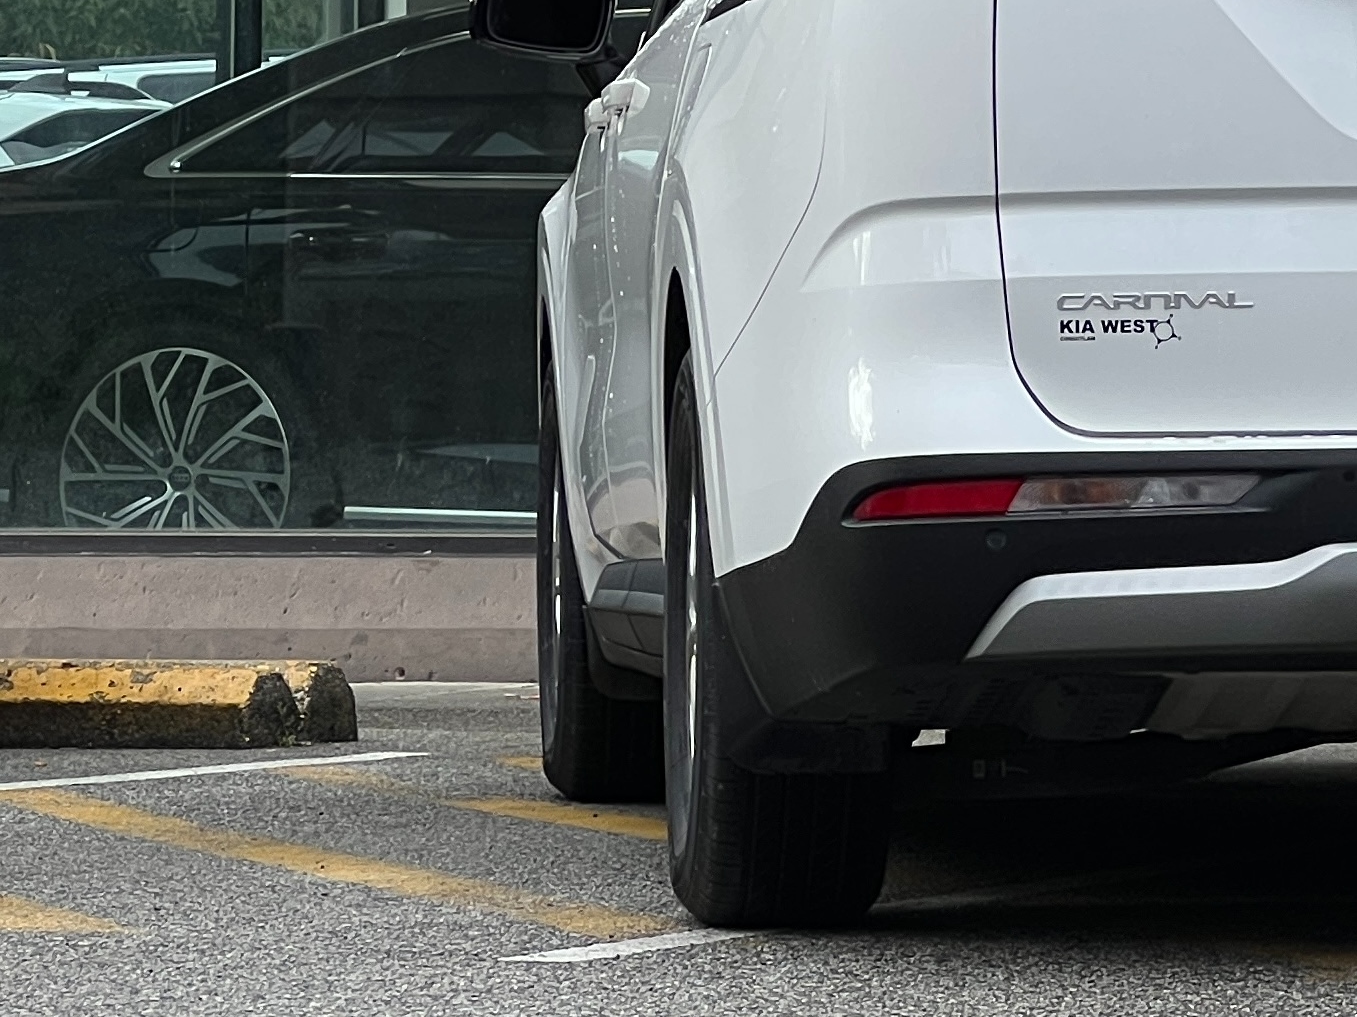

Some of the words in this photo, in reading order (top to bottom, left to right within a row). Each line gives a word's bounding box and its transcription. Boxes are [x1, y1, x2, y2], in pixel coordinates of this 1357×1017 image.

[1056, 290, 1255, 312] CARNIVAL
[1059, 319, 1095, 334] KIA
[1100, 319, 1160, 334] WEST
